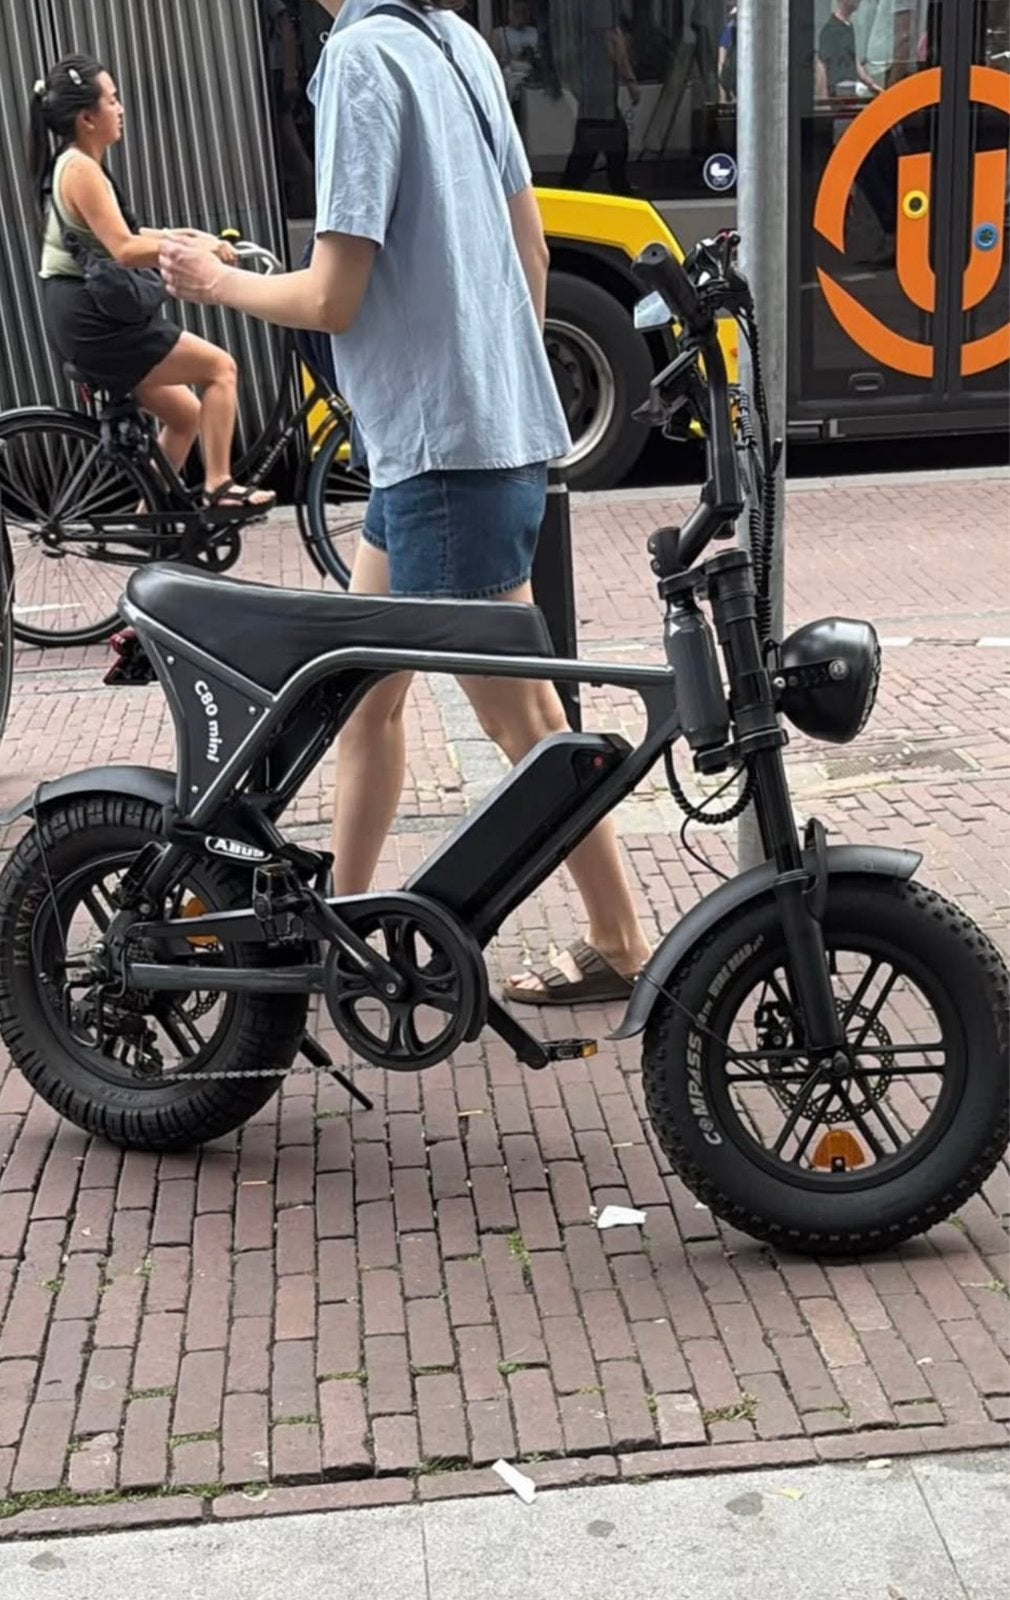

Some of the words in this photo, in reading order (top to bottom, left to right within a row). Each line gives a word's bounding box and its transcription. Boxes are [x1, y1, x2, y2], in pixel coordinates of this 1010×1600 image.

[194, 680, 219, 716] C80
[206, 720, 223, 763] mini
[213, 838, 265, 858] ABUS
[687, 1030, 722, 1145] COMPASS
